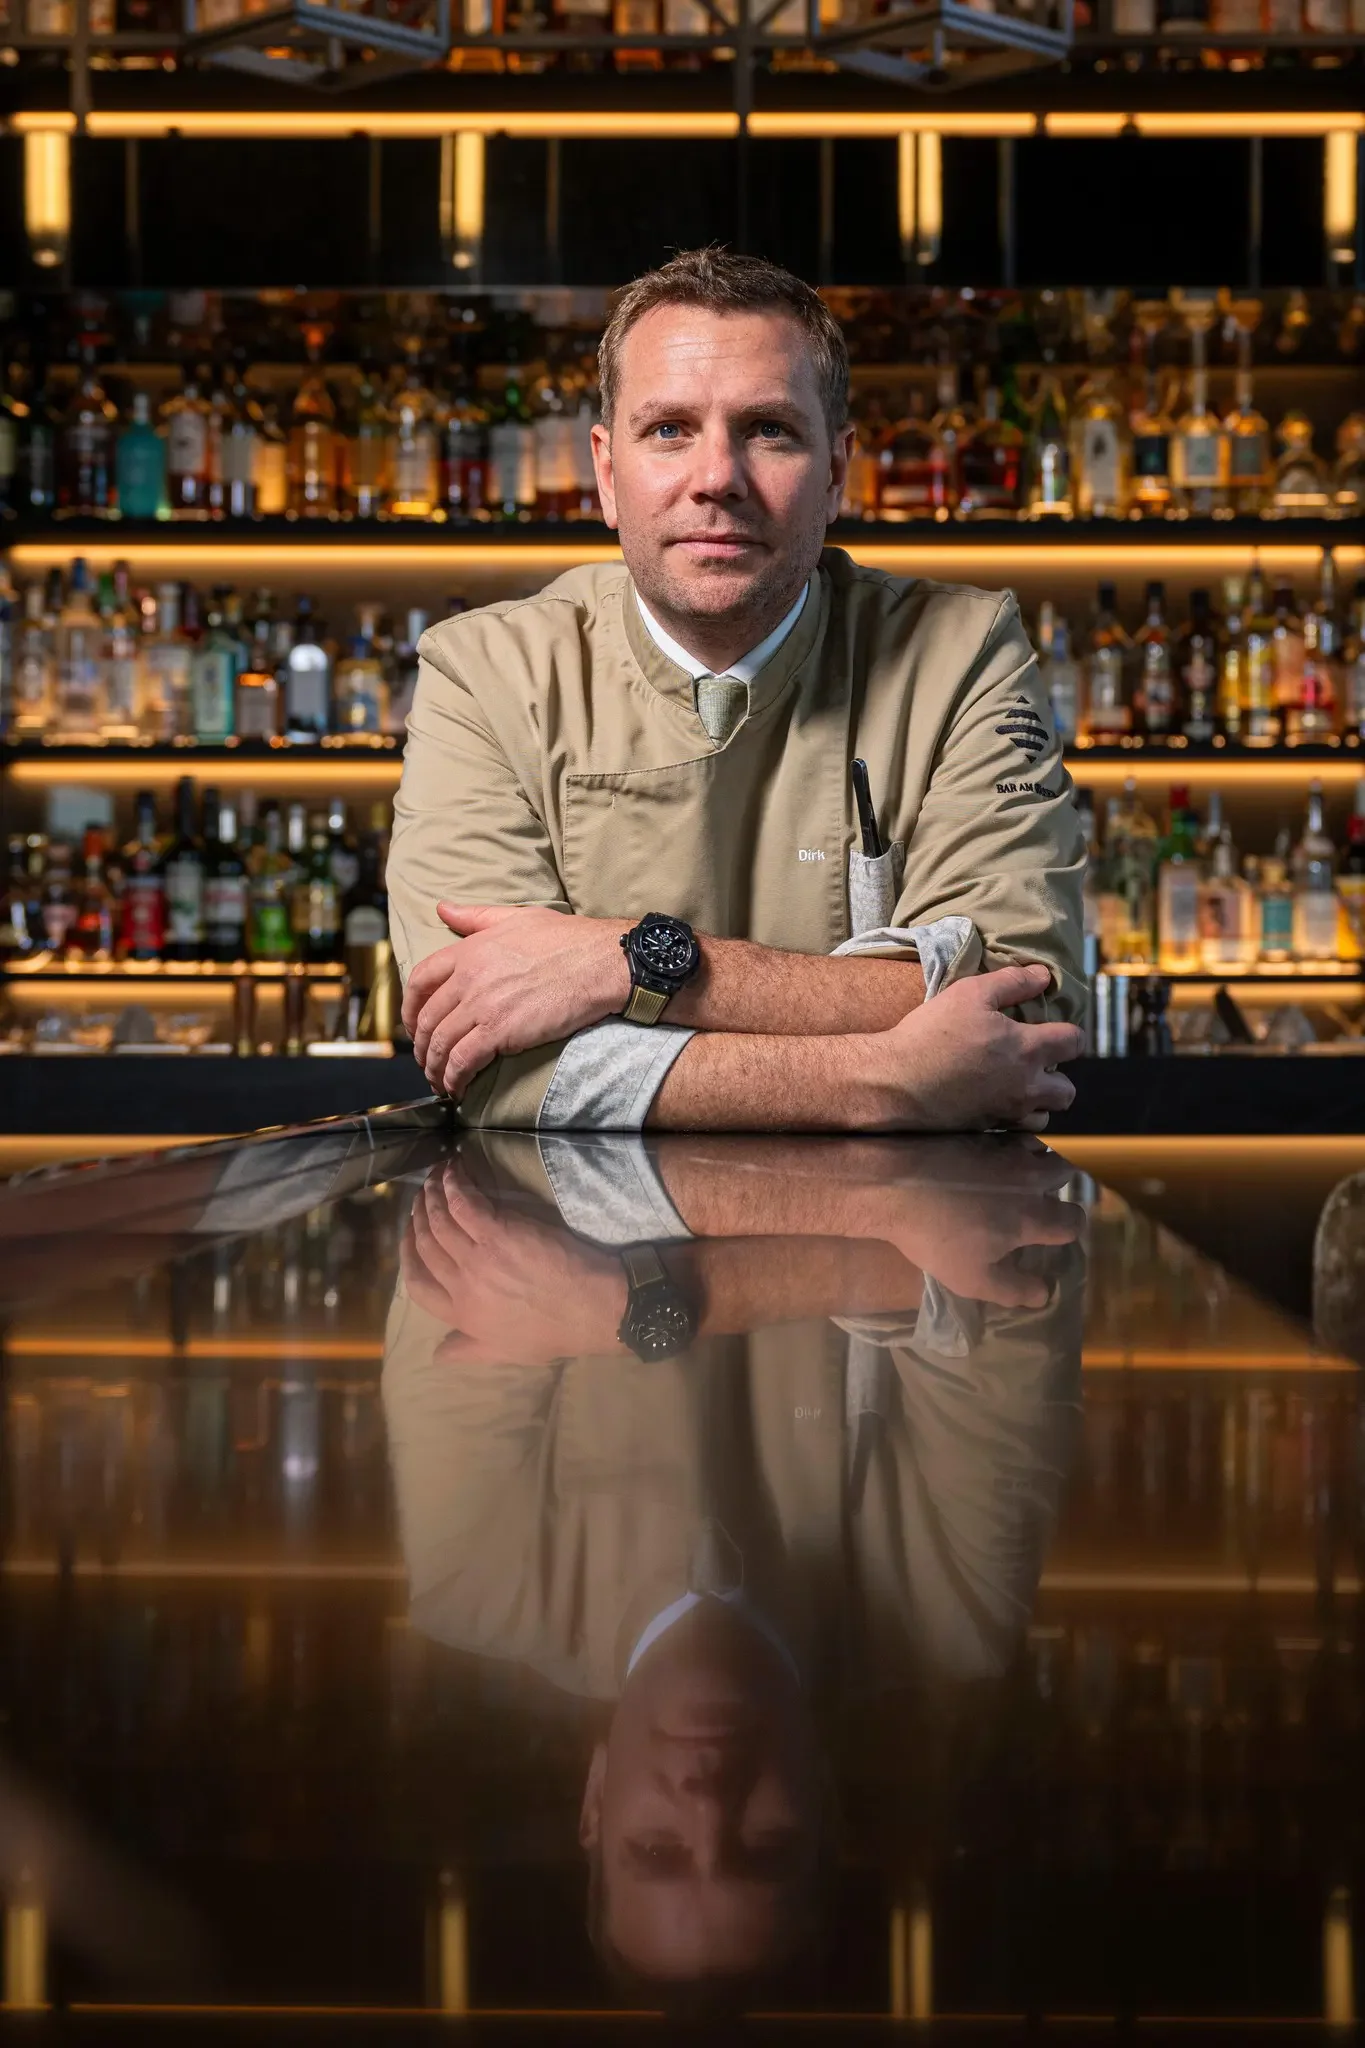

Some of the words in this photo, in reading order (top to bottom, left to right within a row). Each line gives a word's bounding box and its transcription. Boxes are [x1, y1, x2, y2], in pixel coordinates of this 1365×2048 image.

[996, 783, 1018, 794] BAR
[1019, 782, 1034, 792] AM
[798, 849, 826, 862] Dirk
